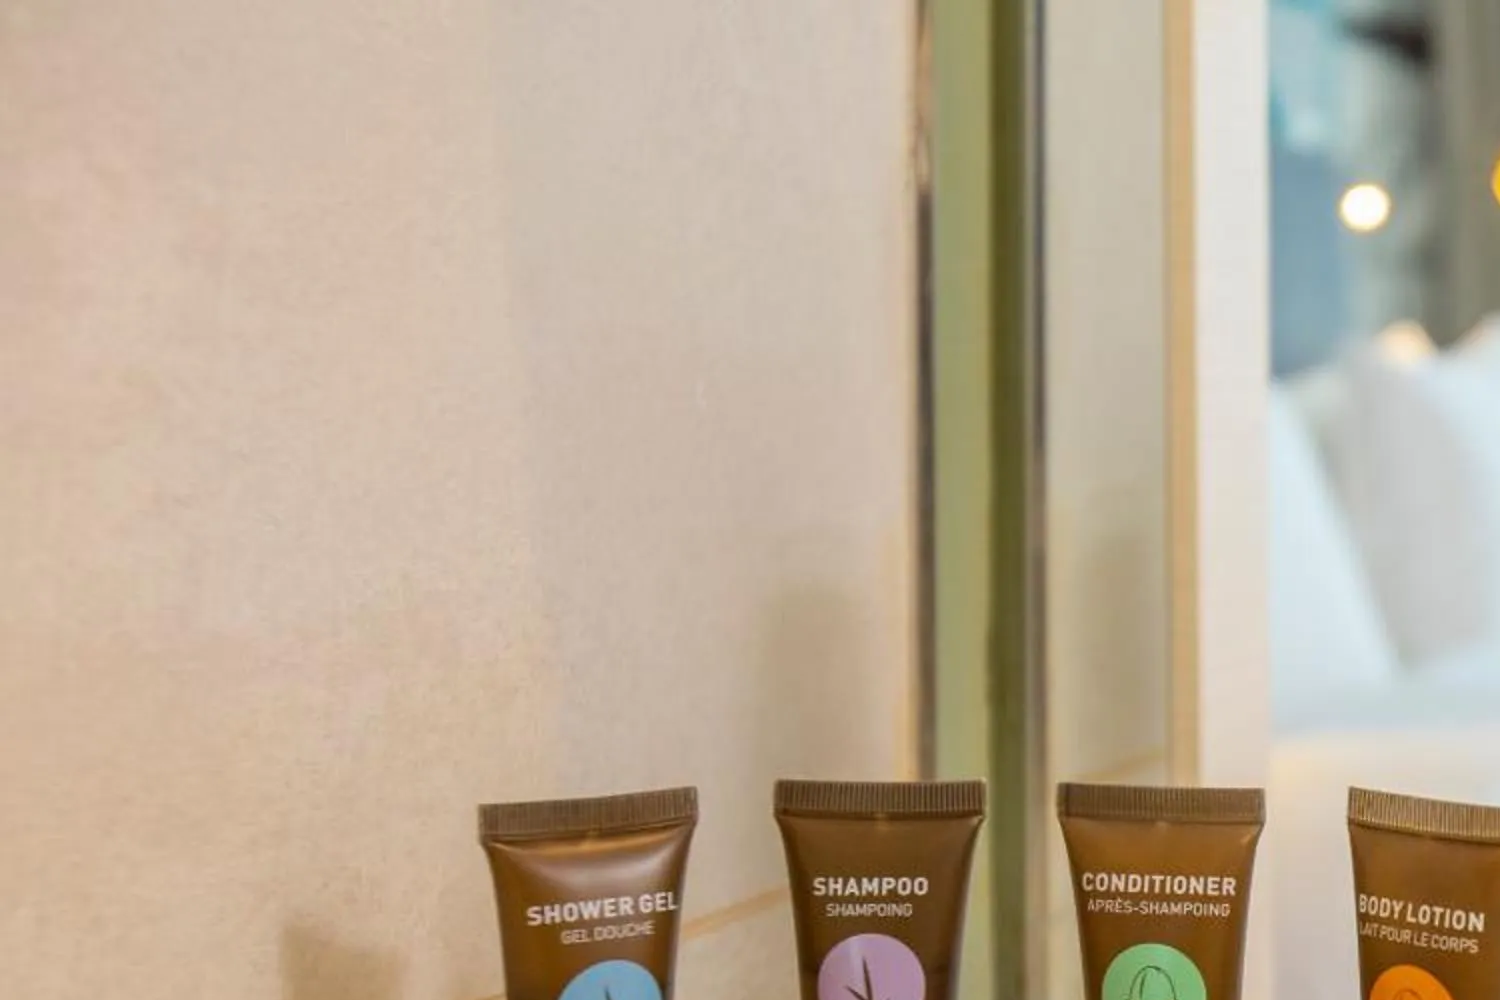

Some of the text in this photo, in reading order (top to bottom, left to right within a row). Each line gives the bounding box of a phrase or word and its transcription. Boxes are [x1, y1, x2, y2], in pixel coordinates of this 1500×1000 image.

[812, 876, 929, 897] SHAMPOO
[1081, 871, 1237, 897] CONDITIONER
[526, 891, 679, 926] SHOWER GEL
[825, 902, 913, 917] SHAMPOING
[1087, 899, 1231, 918] APRÈS-SHAMPOING
[1359, 893, 1486, 933] BODY LOTION
[560, 919, 656, 944] GEL DOUCHE
[1380, 925, 1412, 945] POUR
[1413, 931, 1428, 948] LE
[1430, 933, 1480, 954] CORPS
